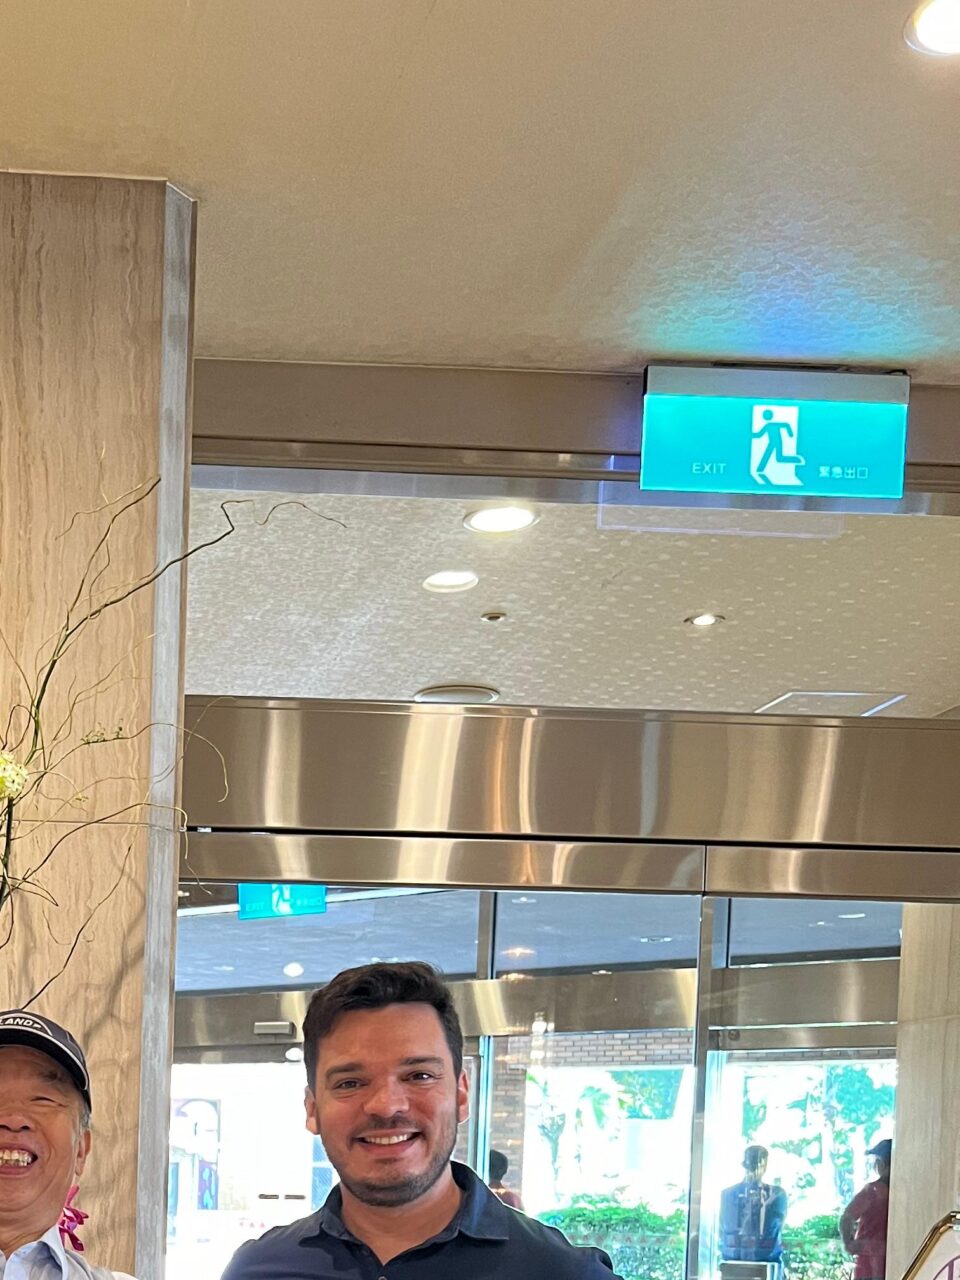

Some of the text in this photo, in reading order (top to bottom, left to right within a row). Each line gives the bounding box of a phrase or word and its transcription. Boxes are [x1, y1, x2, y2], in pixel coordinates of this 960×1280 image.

[692, 462, 727, 475] EXIT
[818, 465, 869, 479] 緊急出口
